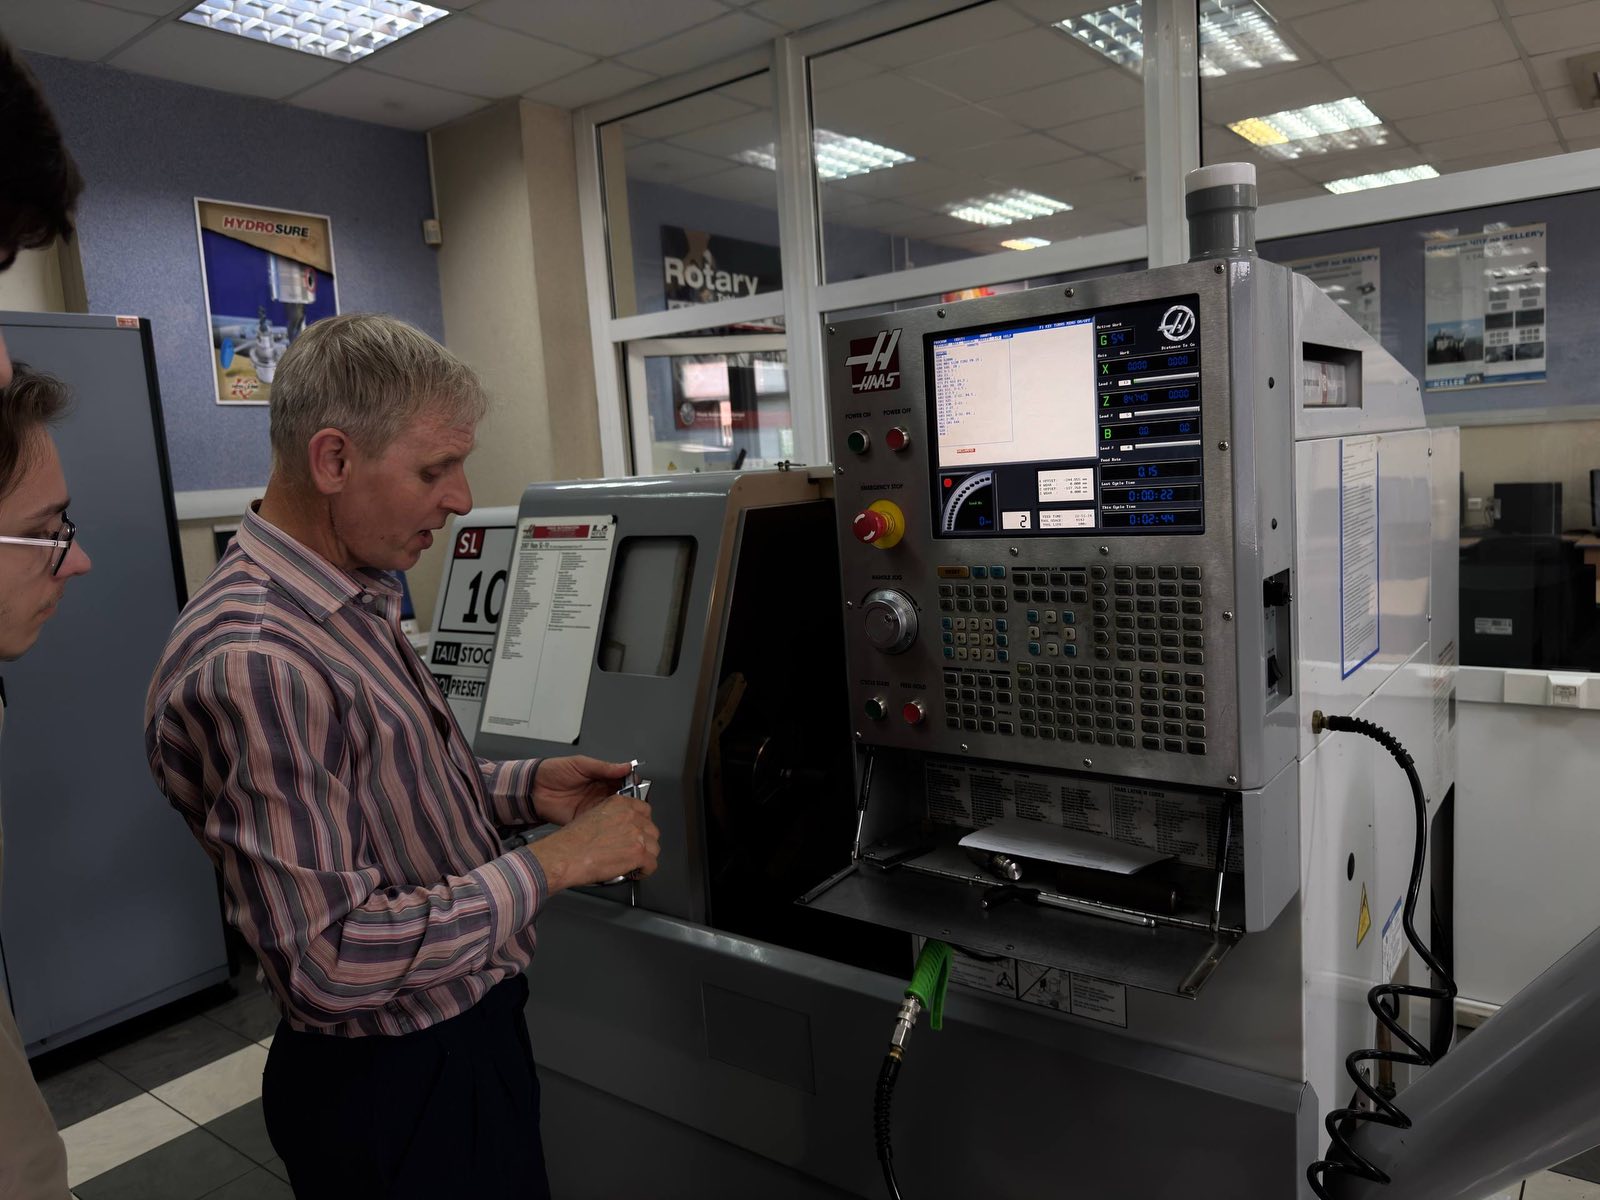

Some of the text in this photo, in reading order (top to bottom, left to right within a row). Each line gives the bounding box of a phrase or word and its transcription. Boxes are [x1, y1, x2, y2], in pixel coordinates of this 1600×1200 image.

[223, 217, 309, 238] HYDROSURE
[664, 256, 759, 295] Rotary
[1100, 334, 1108, 346] G
[1102, 363, 1109, 375] X
[852, 372, 900, 391] HAAS
[1103, 395, 1110, 407] Z
[1104, 428, 1112, 439] B
[1128, 489, 1174, 501] 0:00:22
[1129, 513, 1175, 526] 0:02:44
[459, 532, 478, 554] SL
[462, 569, 507, 624] 10
[435, 645, 458, 662] TAIL
